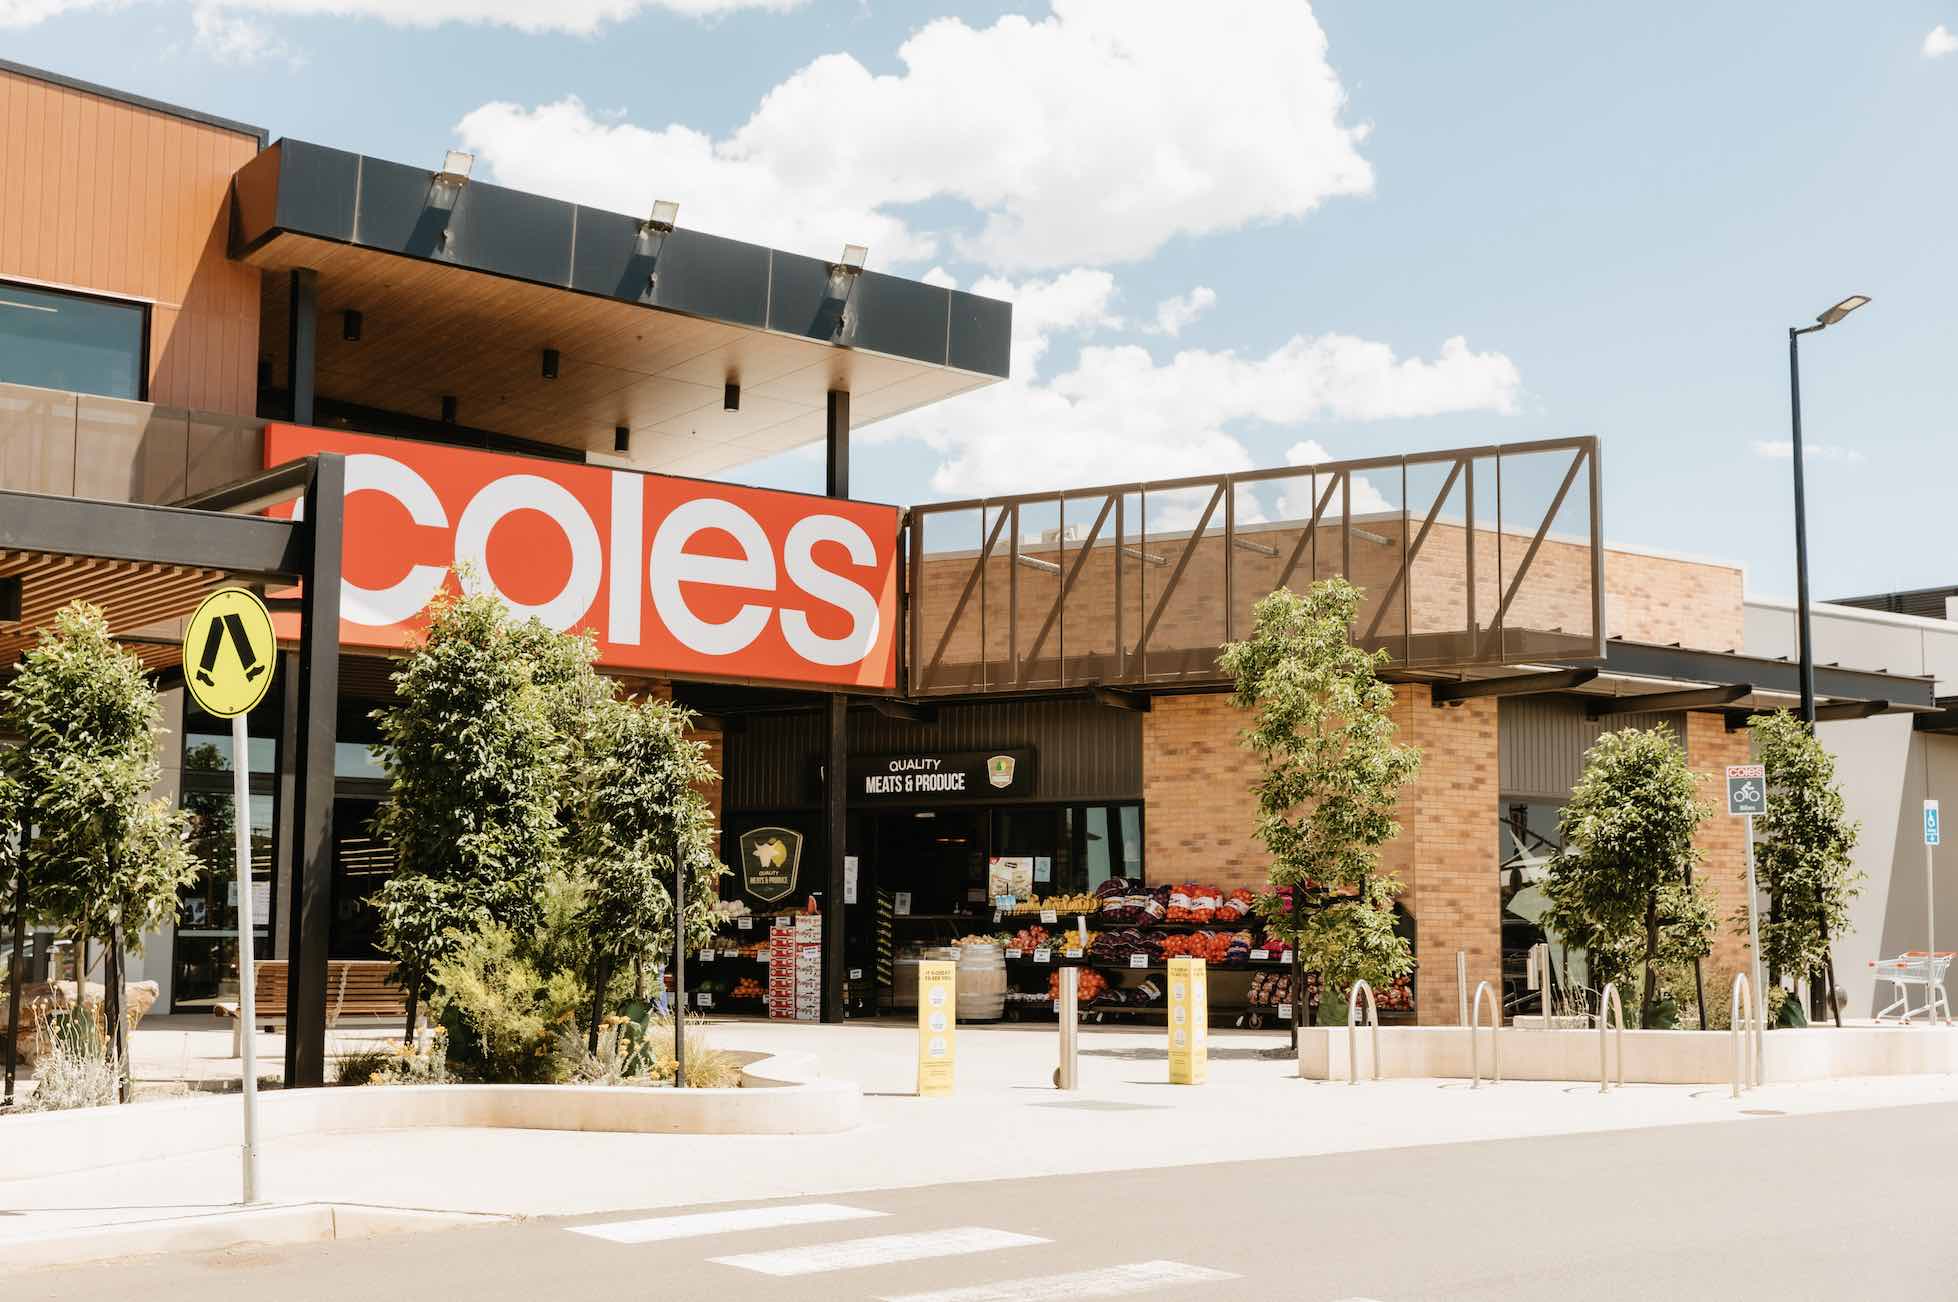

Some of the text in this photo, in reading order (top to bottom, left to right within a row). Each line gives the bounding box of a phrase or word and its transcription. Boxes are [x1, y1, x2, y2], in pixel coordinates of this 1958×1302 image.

[292, 453, 879, 666] coles
[889, 758, 942, 772] QUALITY
[1729, 767, 1762, 777] coles
[866, 772, 965, 794] MEATS & PRODUCE
